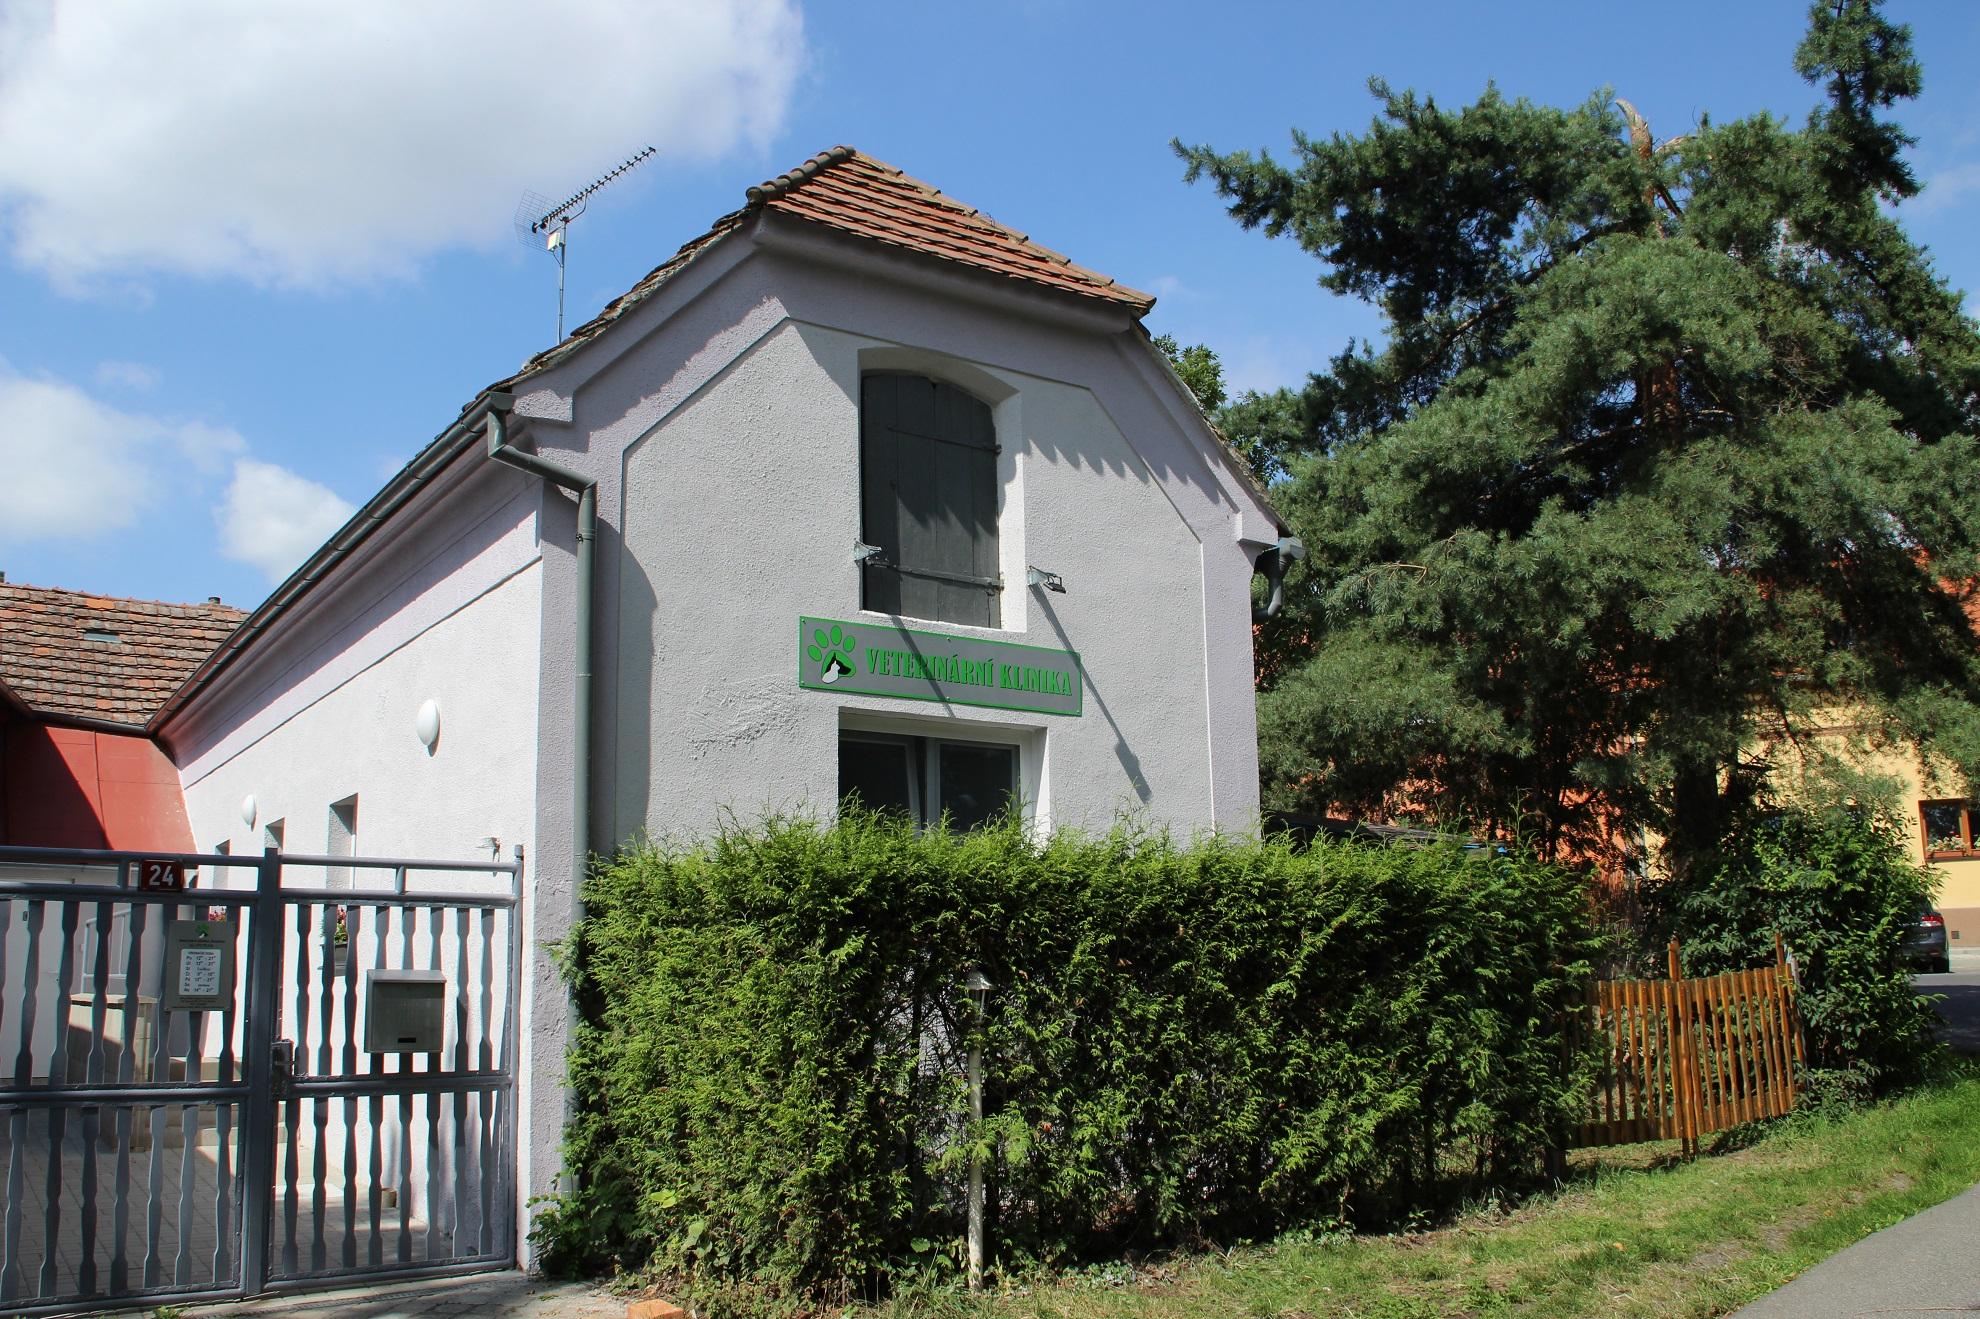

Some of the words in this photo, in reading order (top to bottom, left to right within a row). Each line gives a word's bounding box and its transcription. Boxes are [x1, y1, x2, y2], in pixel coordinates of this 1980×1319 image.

[865, 648, 994, 688] VETERINÁRNÍ
[1000, 664, 1073, 696] KLINIKA
[149, 864, 174, 886] 24
